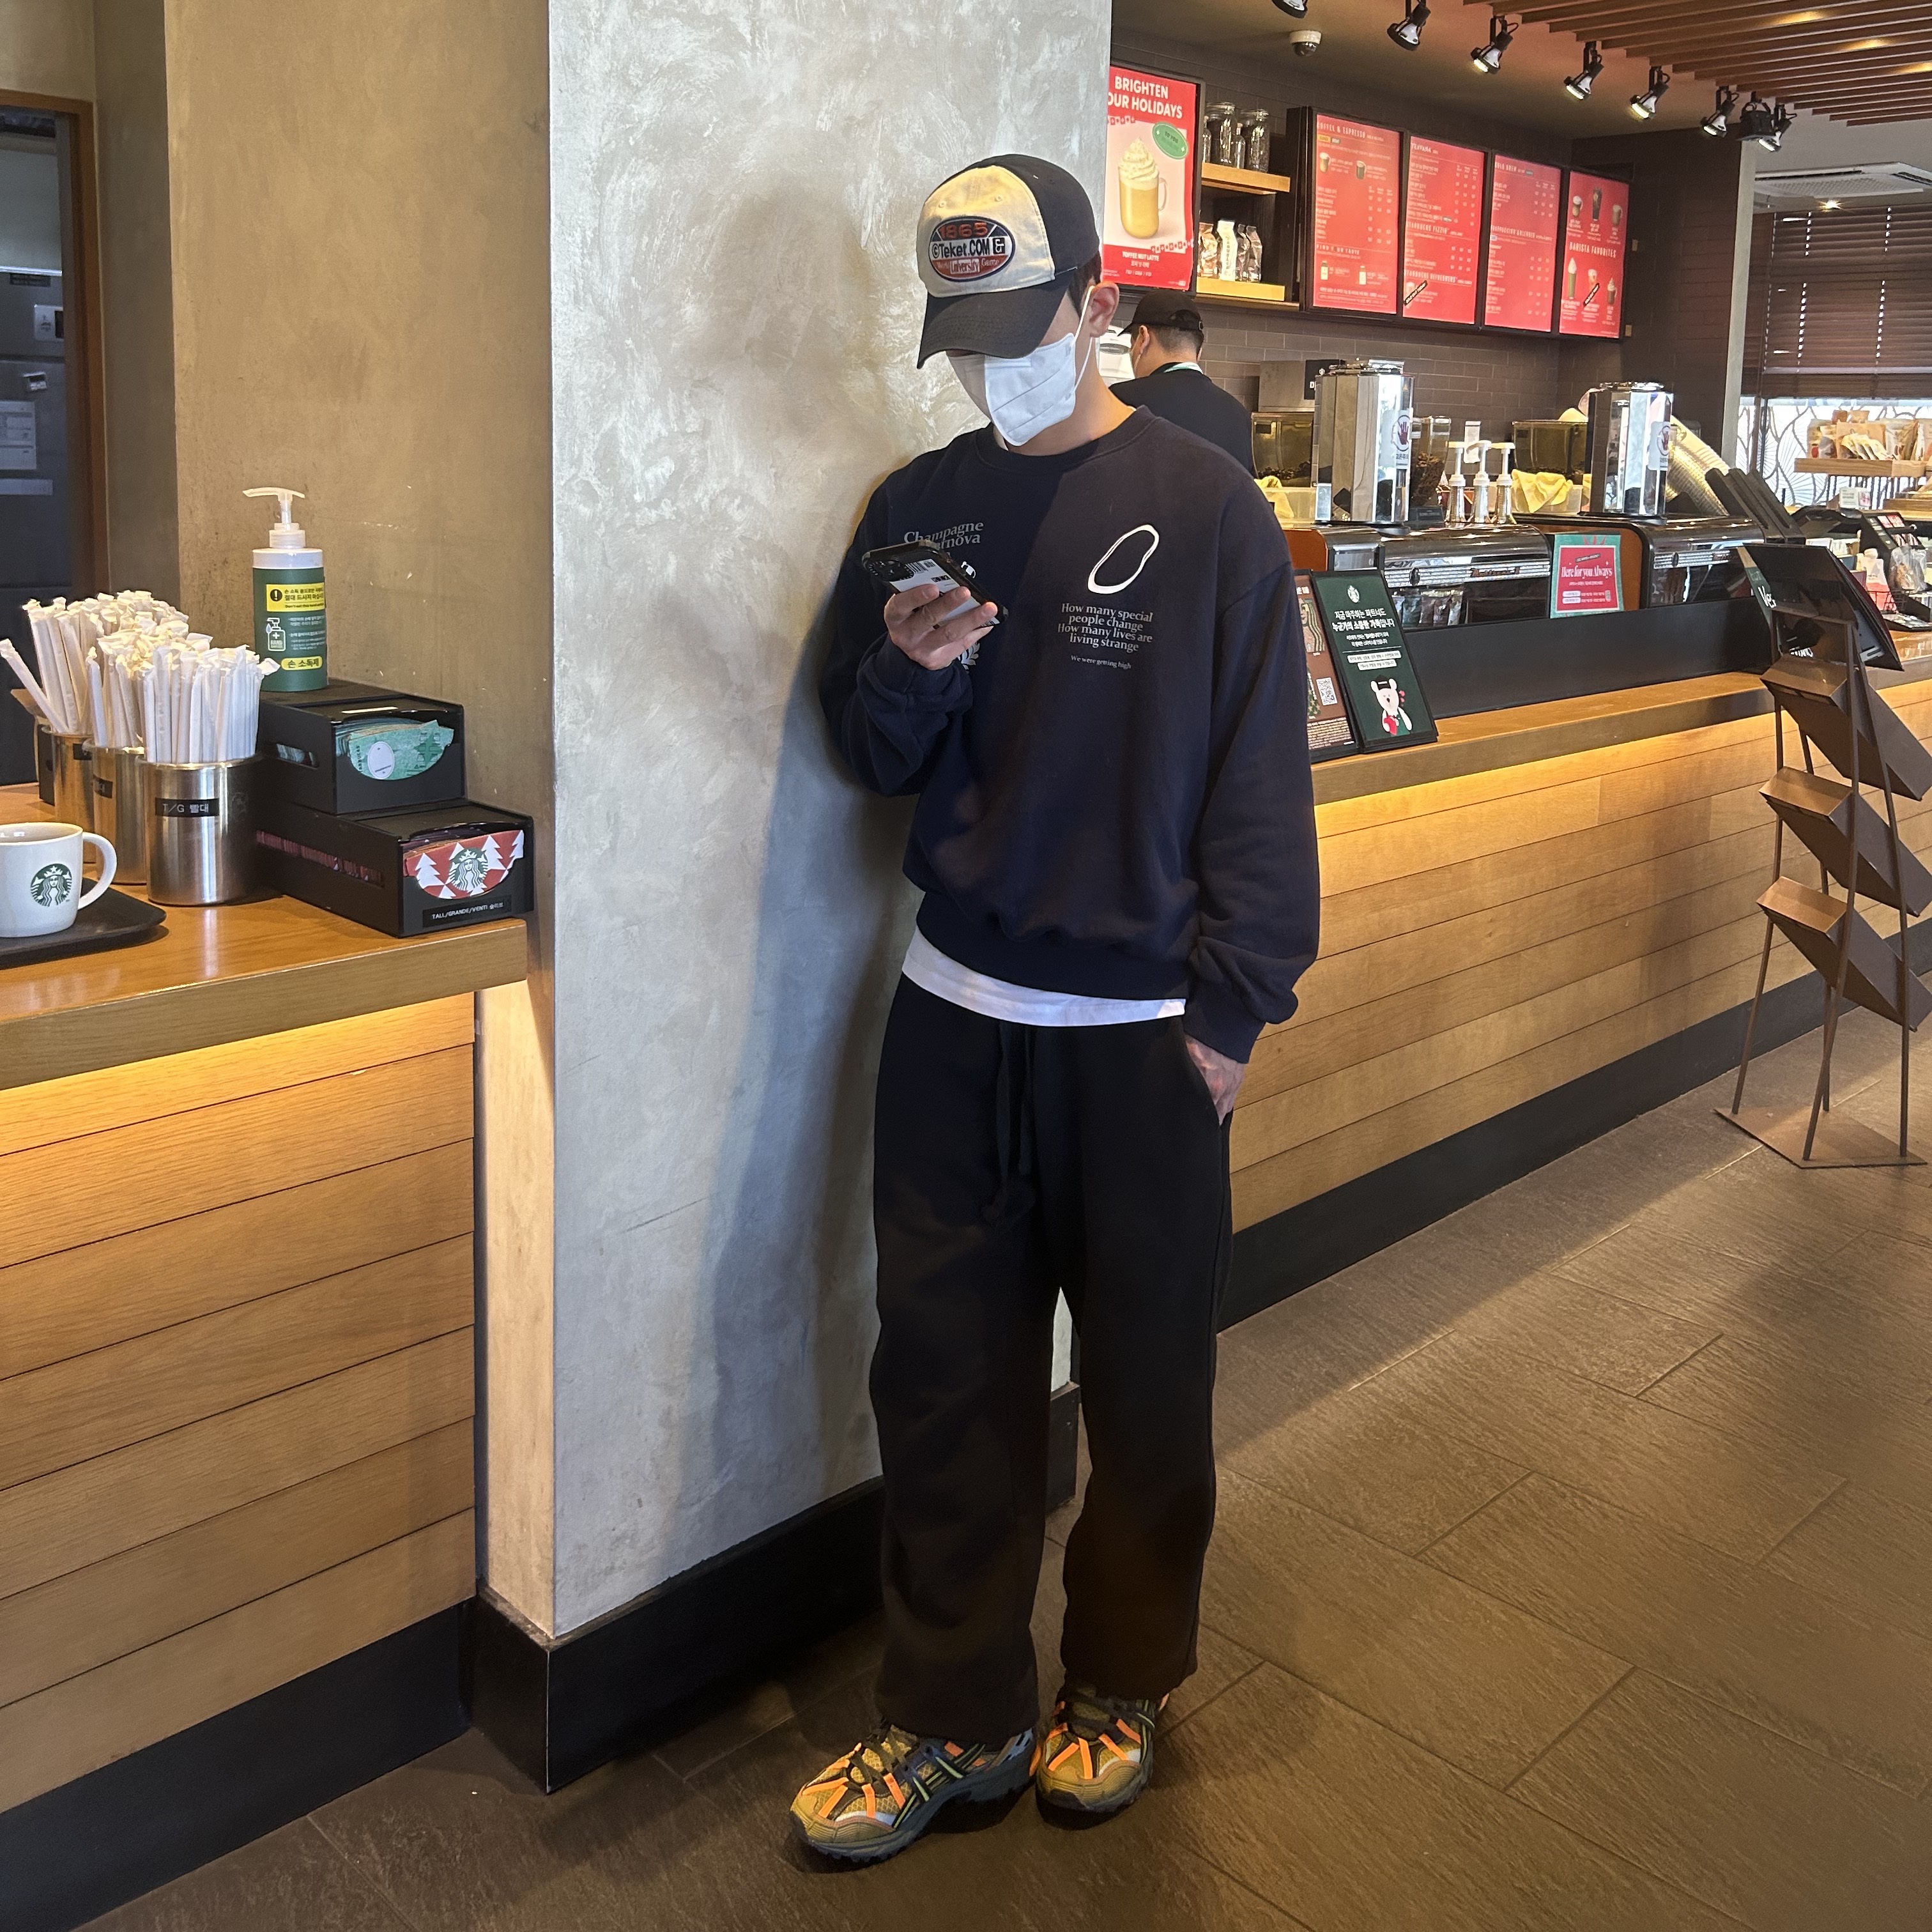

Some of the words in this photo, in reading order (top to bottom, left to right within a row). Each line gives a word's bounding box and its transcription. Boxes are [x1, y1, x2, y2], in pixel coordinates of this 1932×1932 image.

[1114, 75, 1169, 99] BRIGHTEN
[1108, 92, 1129, 109] OUR
[1131, 96, 1183, 119] HOLIDAYS
[1343, 126, 1366, 139] ESPRESSO
[938, 221, 988, 239] 1865
[1569, 241, 1590, 253] BARISTA
[1591, 245, 1616, 258] FAVORITES
[903, 522, 985, 544] Champagne
[937, 534, 981, 549] rnova
[1561, 566, 1574, 578] Here
[1574, 565, 1583, 577] for
[1583, 567, 1593, 579] you
[1594, 565, 1613, 579] Always
[1062, 603, 1084, 613] How
[1086, 606, 1117, 618] many
[1118, 610, 1153, 622] special
[1068, 615, 1105, 626] people
[1107, 617, 1143, 632] change
[1057, 623, 1080, 632] How
[1081, 626, 1112, 639] many
[1113, 627, 1136, 640] lives
[1137, 634, 1153, 643] are
[1070, 632, 1099, 648] living
[1101, 639, 1139, 653] strange
[288, 659, 296, 668] 손
[298, 658, 319, 668] 소독제
[1096, 659, 1117, 668] getting
[1118, 661, 1131, 670] high
[162, 803, 185, 813] T/G
[190, 803, 209, 813] 빨대
[432, 905, 488, 919] TALL/GRANDE/VENTI
